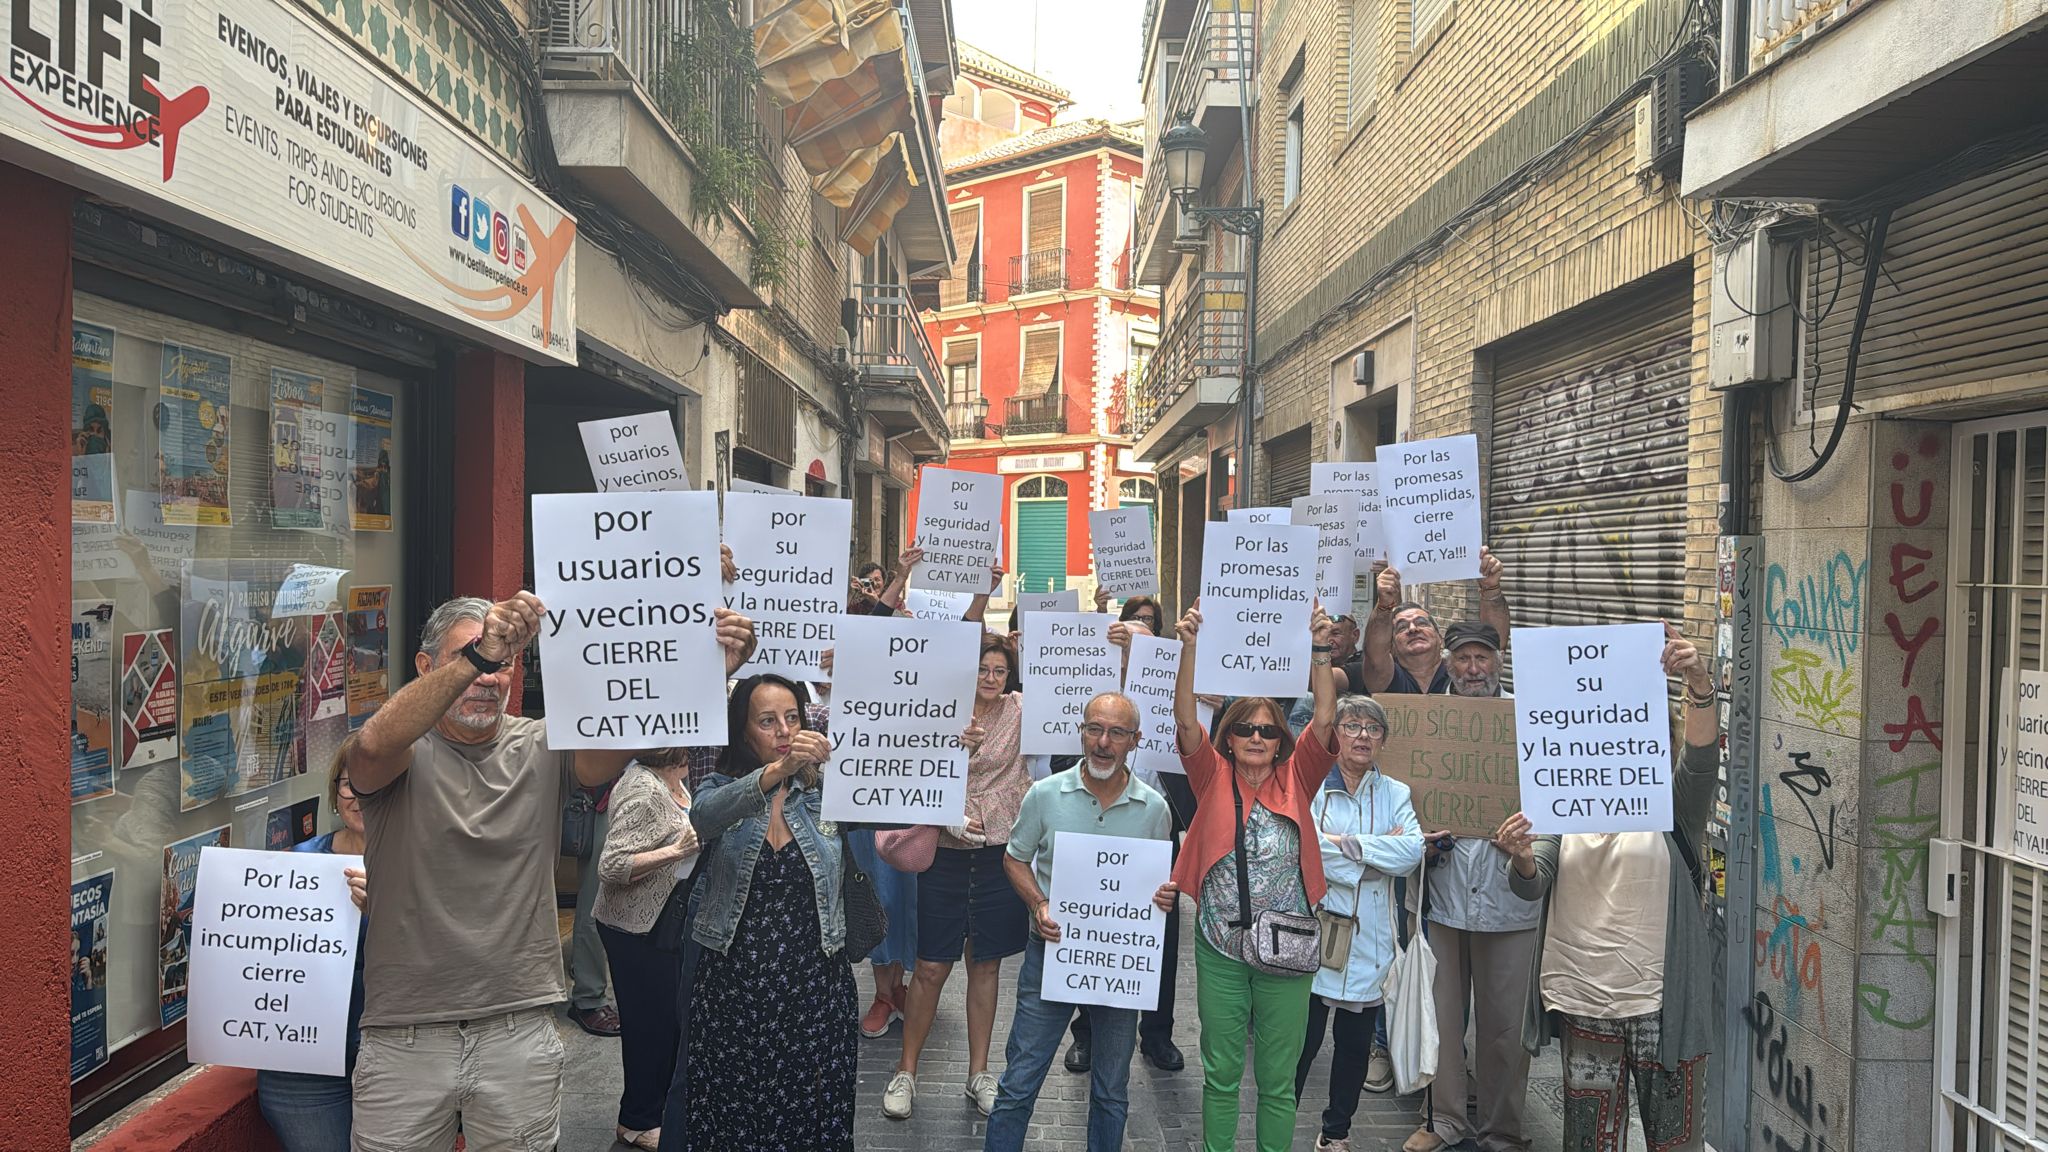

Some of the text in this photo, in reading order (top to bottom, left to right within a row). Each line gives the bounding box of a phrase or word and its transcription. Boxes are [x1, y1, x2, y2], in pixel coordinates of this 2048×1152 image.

[11, 0, 161, 118] LIFE
[11, 47, 161, 148] EXPERIENCE
[218, 13, 428, 171] EVENTOS, VIAJES Y EXCURSIONES
[276, 86, 393, 177] PARA ESTUDIANTES
[225, 105, 417, 229] EVENTS, TRIPS AND EXCURSIONS
[289, 175, 374, 238] FOR STUDENTS
[449, 246, 528, 297] www.bestlifeexperience.es
[610, 424, 638, 443] por
[598, 444, 669, 465] usuarios
[1404, 450, 1450, 466] Por las
[599, 468, 682, 493] y vecinos,
[1333, 470, 1370, 482] Por las
[1394, 470, 1463, 490] promesas
[951, 481, 975, 493] por
[953, 500, 968, 511] su
[1386, 487, 1475, 508] incumplidas,
[1250, 512, 1271, 523] por
[1307, 502, 1338, 517] Por las
[1414, 511, 1454, 524] cierre
[594, 510, 652, 540] por
[771, 512, 806, 530] por
[924, 517, 990, 532] seguridad
[1110, 516, 1127, 527] por
[917, 533, 995, 553] y la nuestra,
[1114, 530, 1126, 539] su
[1424, 528, 1446, 543] del
[776, 541, 797, 555] su
[1097, 540, 1146, 556] seguridad
[1235, 536, 1288, 553] Por las
[921, 552, 990, 568] CIERRE DEL
[1103, 558, 1112, 568] la
[1113, 556, 1154, 568] nuestra,
[1407, 546, 1467, 564] CAT, Ya!!!
[558, 550, 701, 582] usuarios
[1100, 567, 1155, 582] CIERRE DEL
[1220, 563, 1299, 577] promesas
[734, 566, 833, 587] seguridad
[927, 569, 980, 584] CAT YA!!!
[1109, 580, 1149, 593] CAT YA!!!
[1207, 582, 1309, 604] incumplidas,
[1316, 587, 1338, 597] Ya!!!
[741, 592, 757, 610] la
[764, 597, 843, 614] nuestra,
[930, 598, 948, 609] DEL
[1040, 600, 1058, 611] por
[546, 598, 714, 637] y vecinos,
[916, 610, 936, 620] CAT
[1236, 608, 1282, 624] cierre
[198, 597, 298, 681] Algarve
[752, 621, 836, 640] ERRE DEL
[1052, 623, 1096, 637] Por las
[1245, 631, 1270, 647] del
[583, 639, 678, 665] CIERRE
[889, 637, 929, 657] por
[1040, 646, 1106, 659] promesas
[1155, 647, 1177, 661] Por
[1568, 644, 1609, 665] por
[1029, 662, 1116, 679] incumplidas,
[1221, 654, 1291, 672] CAT, Ya!!!
[893, 670, 918, 685] su
[1577, 677, 1602, 692] su
[607, 678, 660, 701] DEL
[1054, 683, 1093, 696] cierre
[2019, 682, 2041, 701] por
[843, 698, 957, 721] seguridad
[1062, 702, 1083, 715] del
[1151, 704, 1174, 716] cier
[1529, 702, 1649, 730] seguridad
[577, 712, 699, 737] CAT YA!!!!
[1042, 721, 1071, 736] CAT,
[1156, 722, 1176, 736] del
[1492, 713, 1517, 745] DE
[832, 727, 966, 752] y la nuestra,
[1137, 738, 1162, 754] CAT,
[1522, 736, 1666, 762] y la nuestra,
[839, 758, 960, 779] CIERRE DEL
[1410, 749, 1433, 779] ES
[1534, 767, 1664, 787] CIERRE DEL
[852, 788, 943, 808] CAT YA!!!
[1552, 797, 1648, 817] CAT YA!!!
[2017, 803, 2037, 825] DEL
[1097, 851, 1129, 868] por
[244, 868, 319, 890] Por las
[1100, 878, 1120, 892] su
[221, 903, 334, 922] promesas
[1059, 901, 1152, 921] seguridad
[201, 928, 347, 957] incumplidas,
[1066, 922, 1160, 950] la nuestra,
[1056, 947, 1155, 972] CIERRE DEL
[242, 962, 306, 984] cierre
[1066, 973, 1141, 996] CAT YA!!!
[254, 992, 288, 1012] del
[223, 1019, 317, 1044] CAT, Ya!!!
